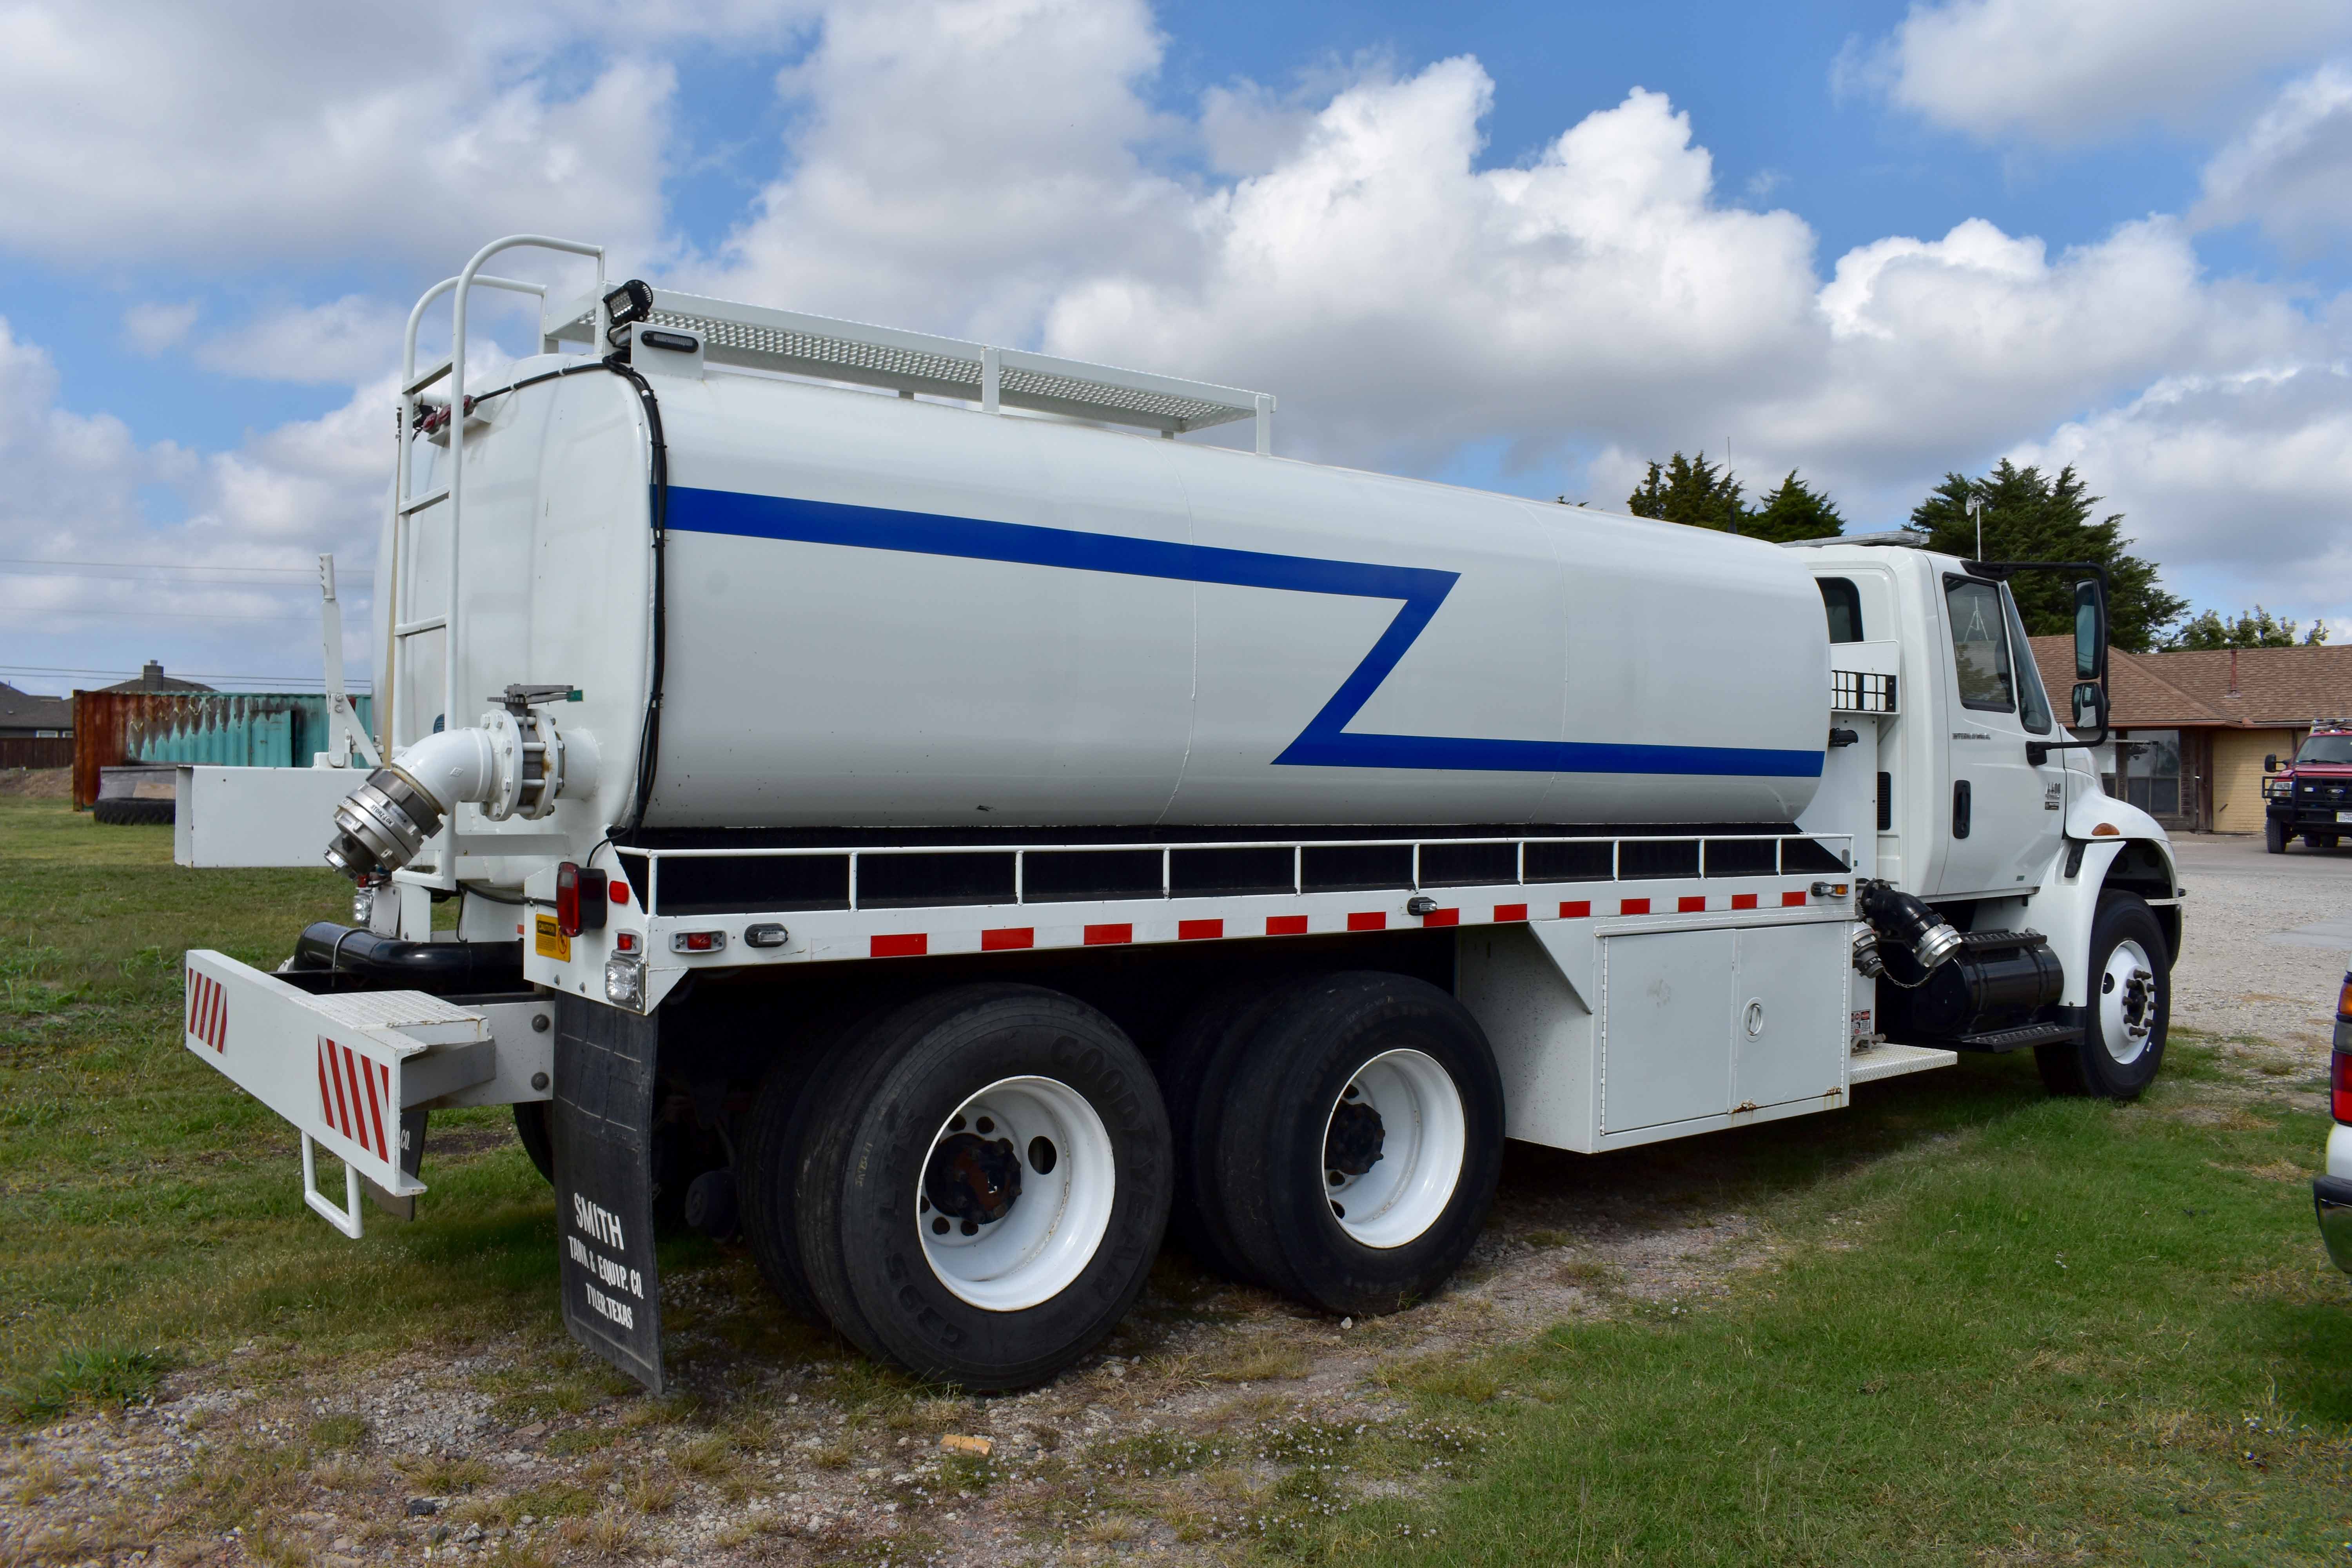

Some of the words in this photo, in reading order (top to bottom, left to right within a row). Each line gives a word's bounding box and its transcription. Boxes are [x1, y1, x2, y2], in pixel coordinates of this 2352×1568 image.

[401, 1129, 410, 1150] CO.
[574, 1192, 624, 1250] SMITH
[568, 1235, 589, 1269] TANK
[590, 1250, 596, 1273] &
[597, 1255, 628, 1290] EQUIP.
[630, 1269, 644, 1299] CO.
